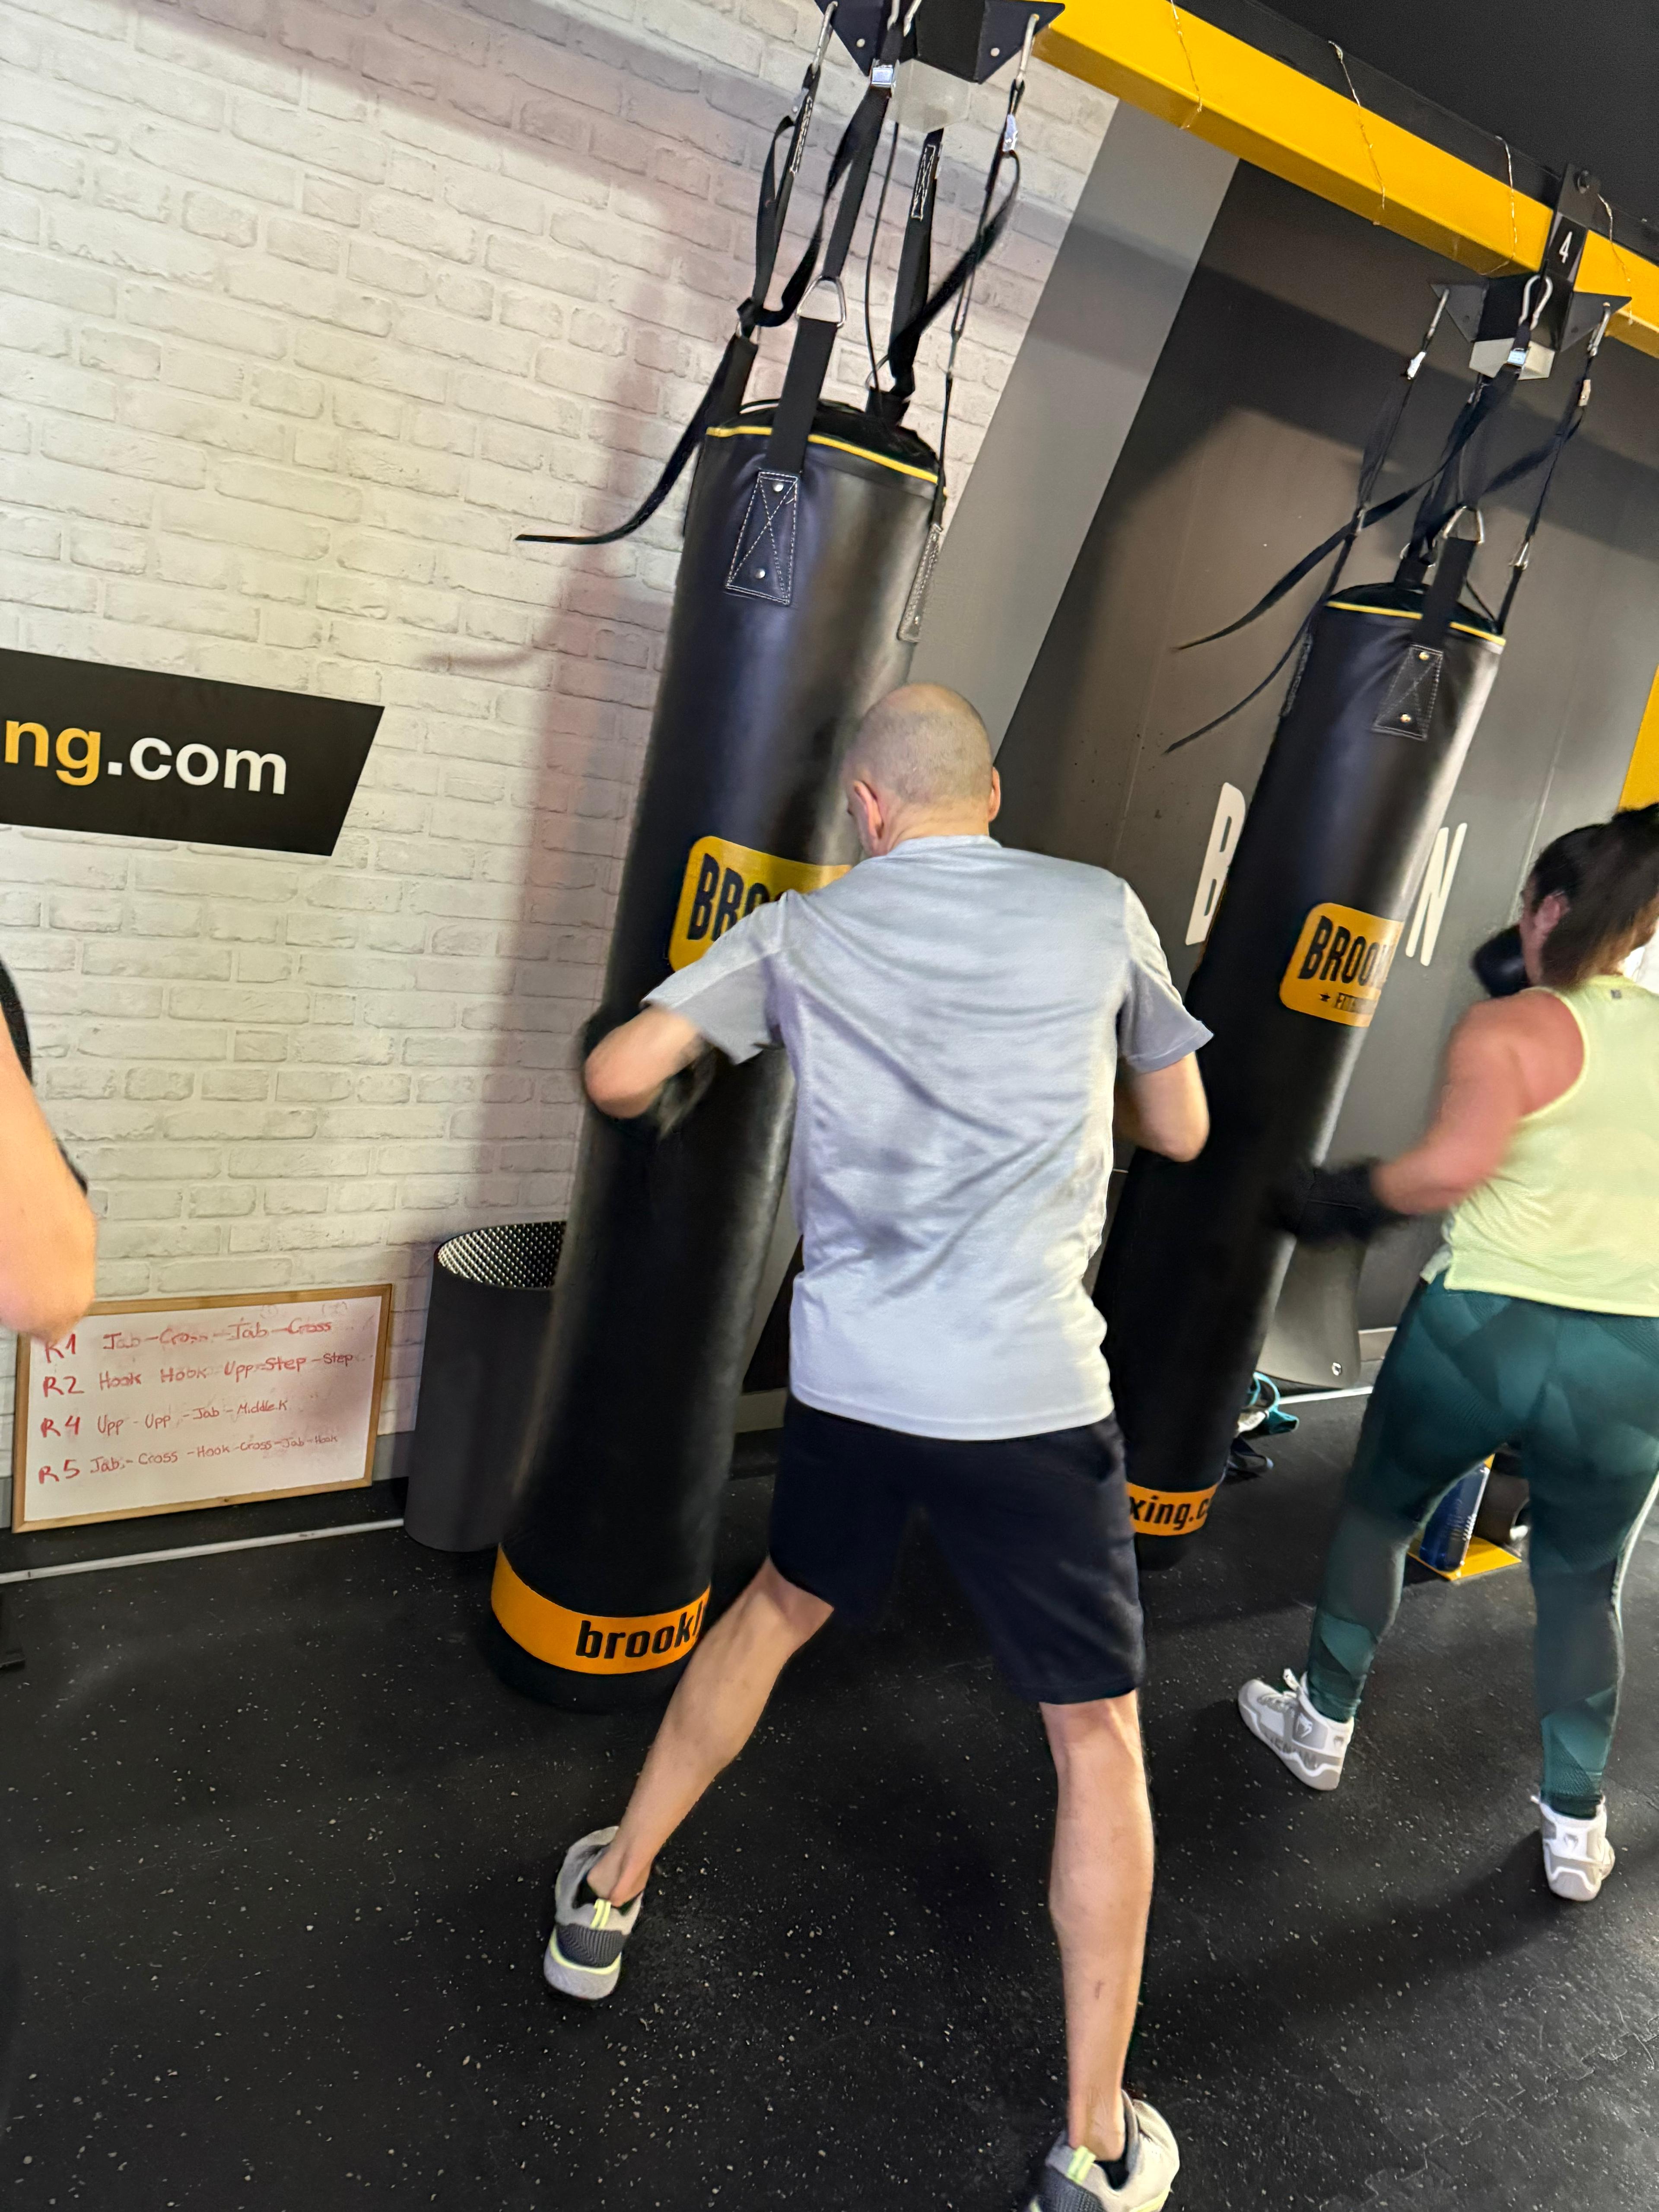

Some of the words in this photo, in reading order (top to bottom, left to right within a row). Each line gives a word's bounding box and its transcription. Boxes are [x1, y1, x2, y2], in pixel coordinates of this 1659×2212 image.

[1559, 232, 1572, 263] 4
[4, 720, 287, 795] ng.com
[1297, 915, 1386, 986] BROO
[43, 1376, 85, 1397] R2
[160, 1367, 207, 1382] Hook
[41, 1415, 80, 1438] R4
[38, 1459, 80, 1484] R5
